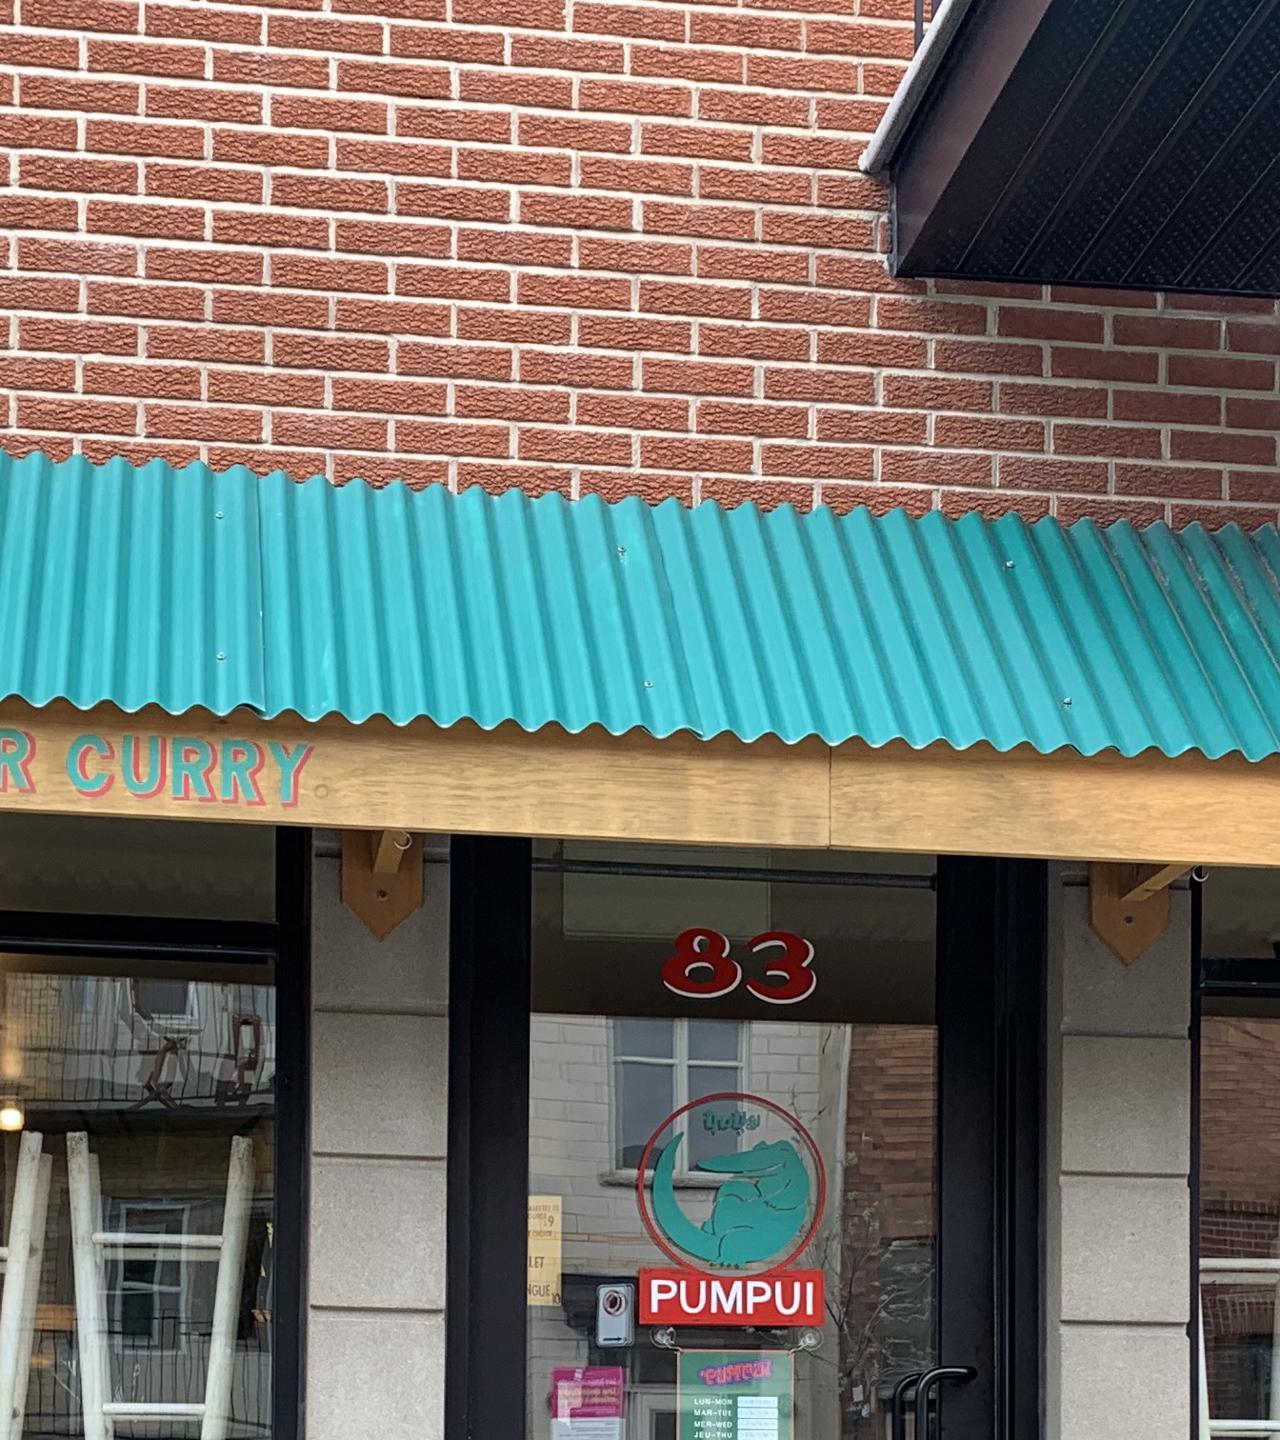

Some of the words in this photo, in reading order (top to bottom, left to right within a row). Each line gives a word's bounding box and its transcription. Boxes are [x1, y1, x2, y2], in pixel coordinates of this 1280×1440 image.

[66, 733, 315, 808] CURRY
[661, 927, 818, 1005] 83
[650, 1279, 814, 1315] PUMPUI
